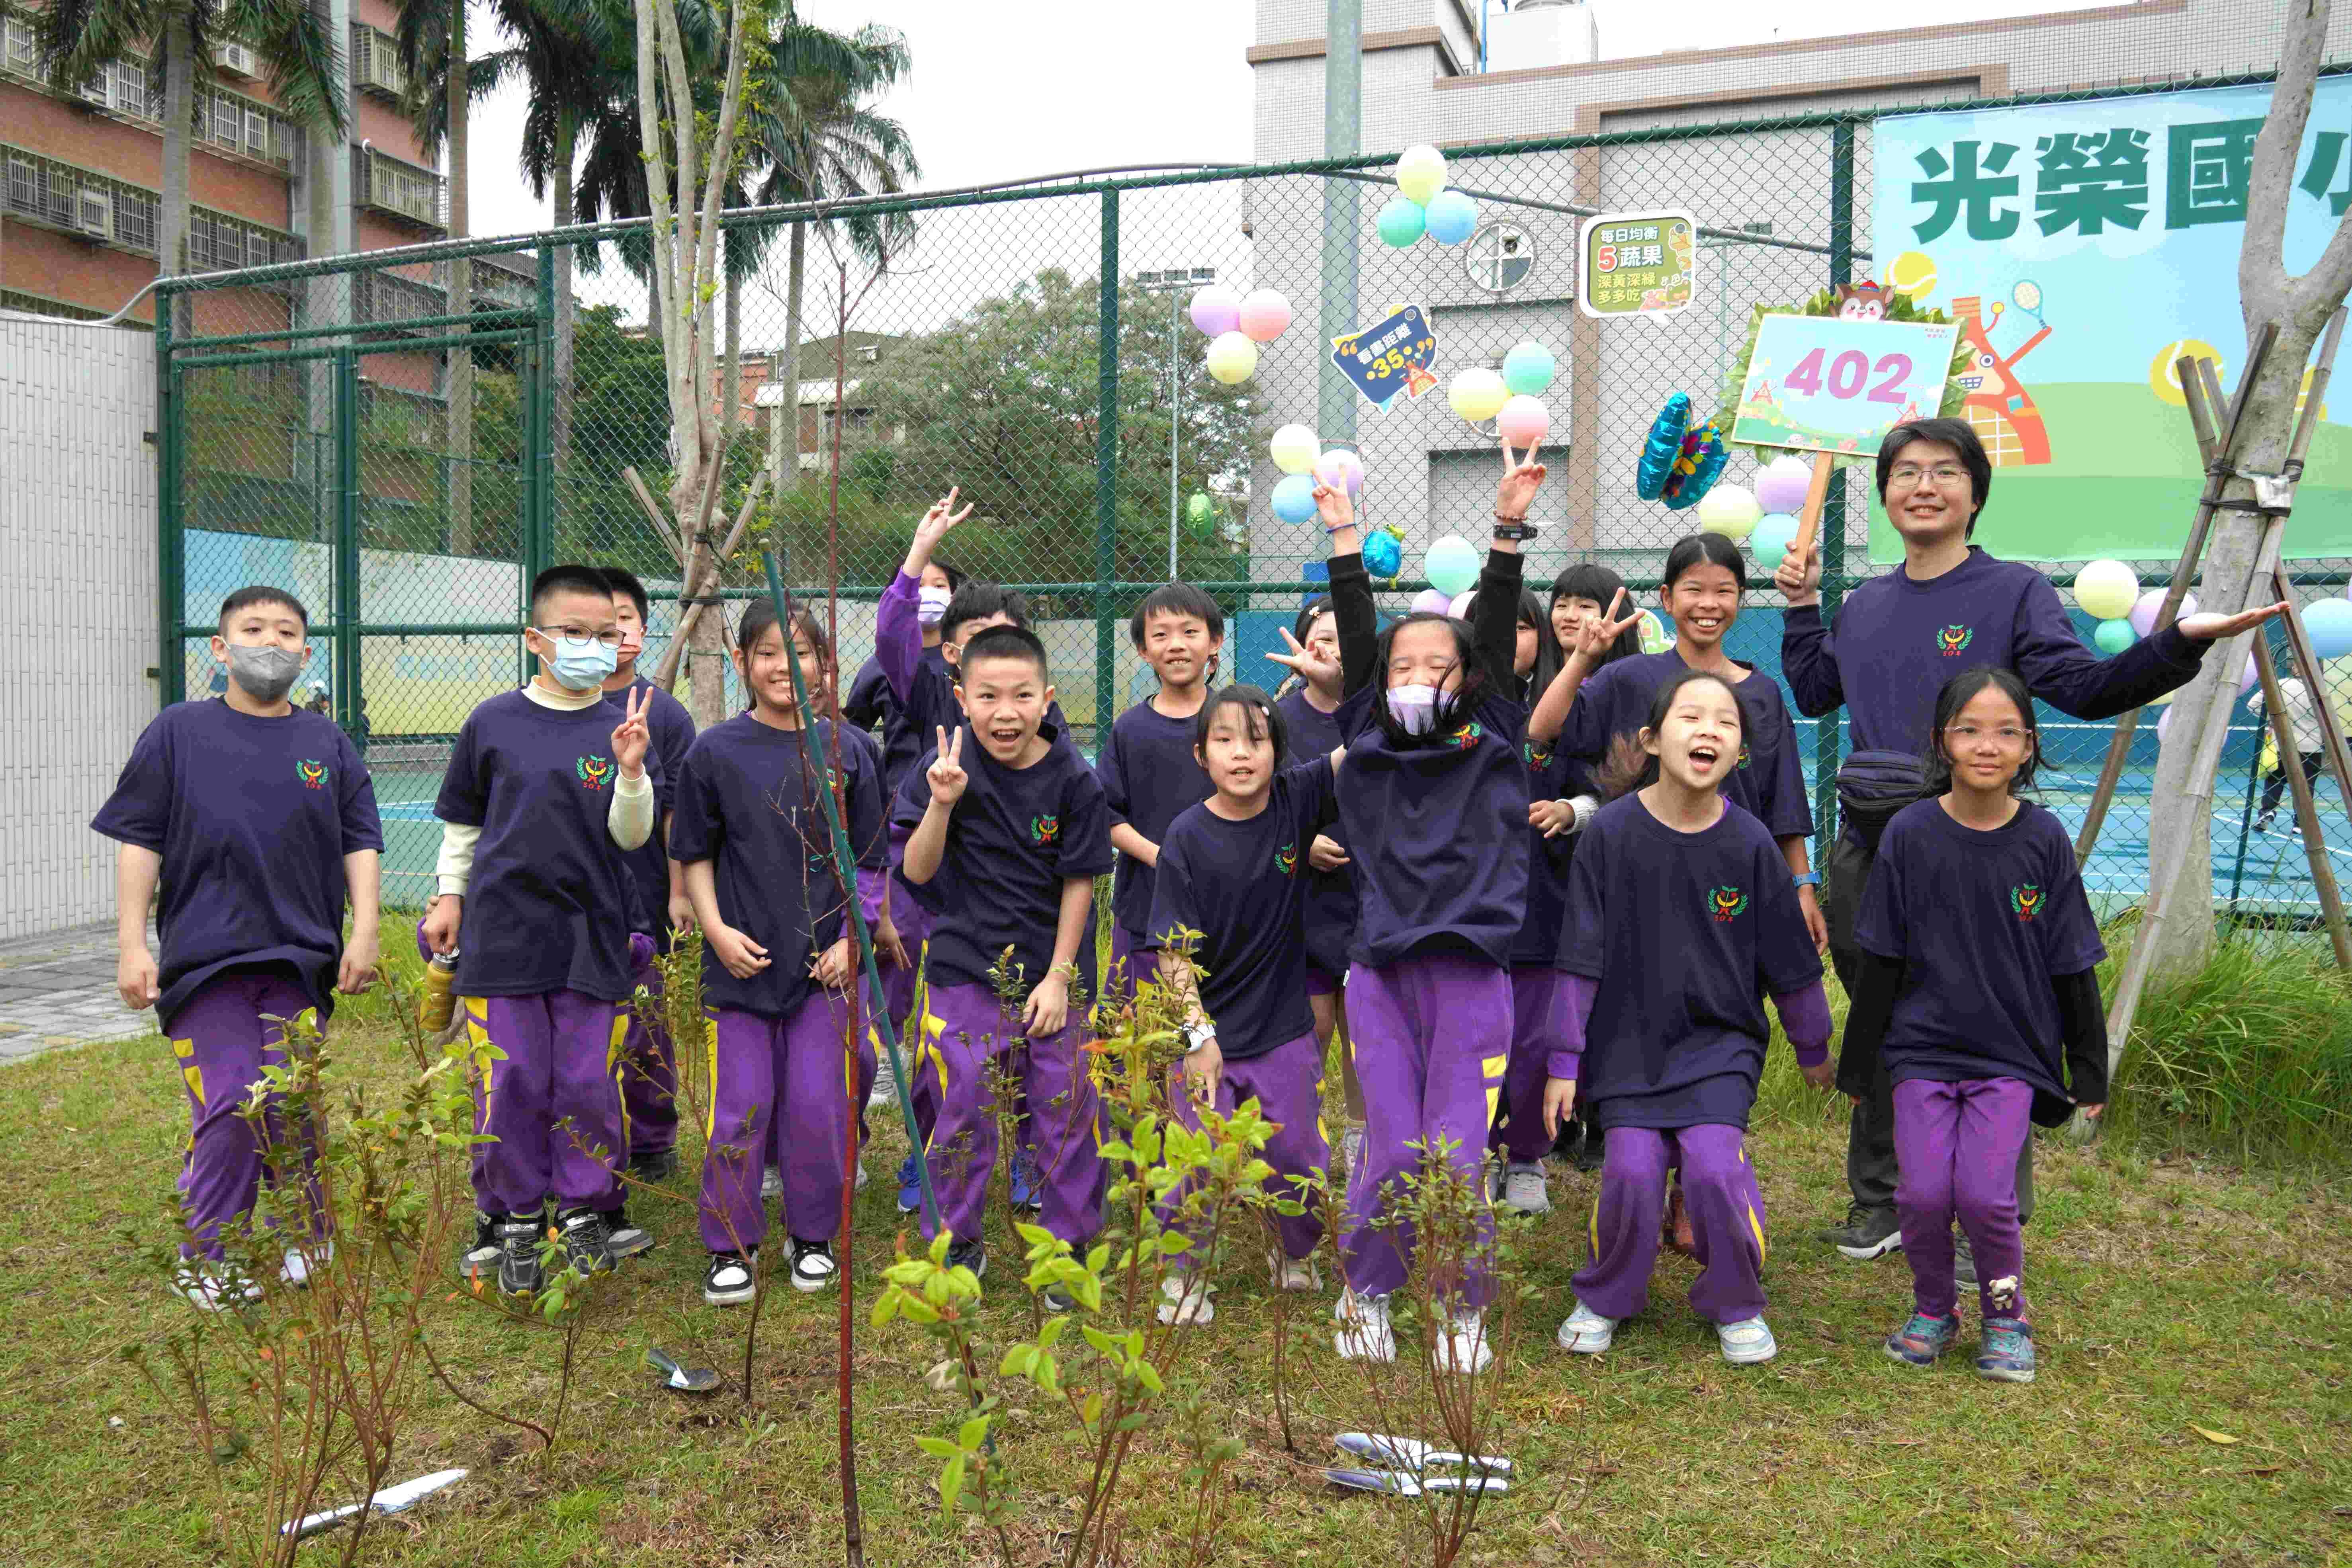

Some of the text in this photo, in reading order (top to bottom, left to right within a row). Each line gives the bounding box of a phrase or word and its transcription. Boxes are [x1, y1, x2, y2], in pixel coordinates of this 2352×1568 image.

[1601, 227, 1658, 242] 每日均衡
[1598, 273, 1656, 288] 深黃深綠
[1598, 289, 1640, 304] 多多吃
[1784, 348, 1912, 404] 402
